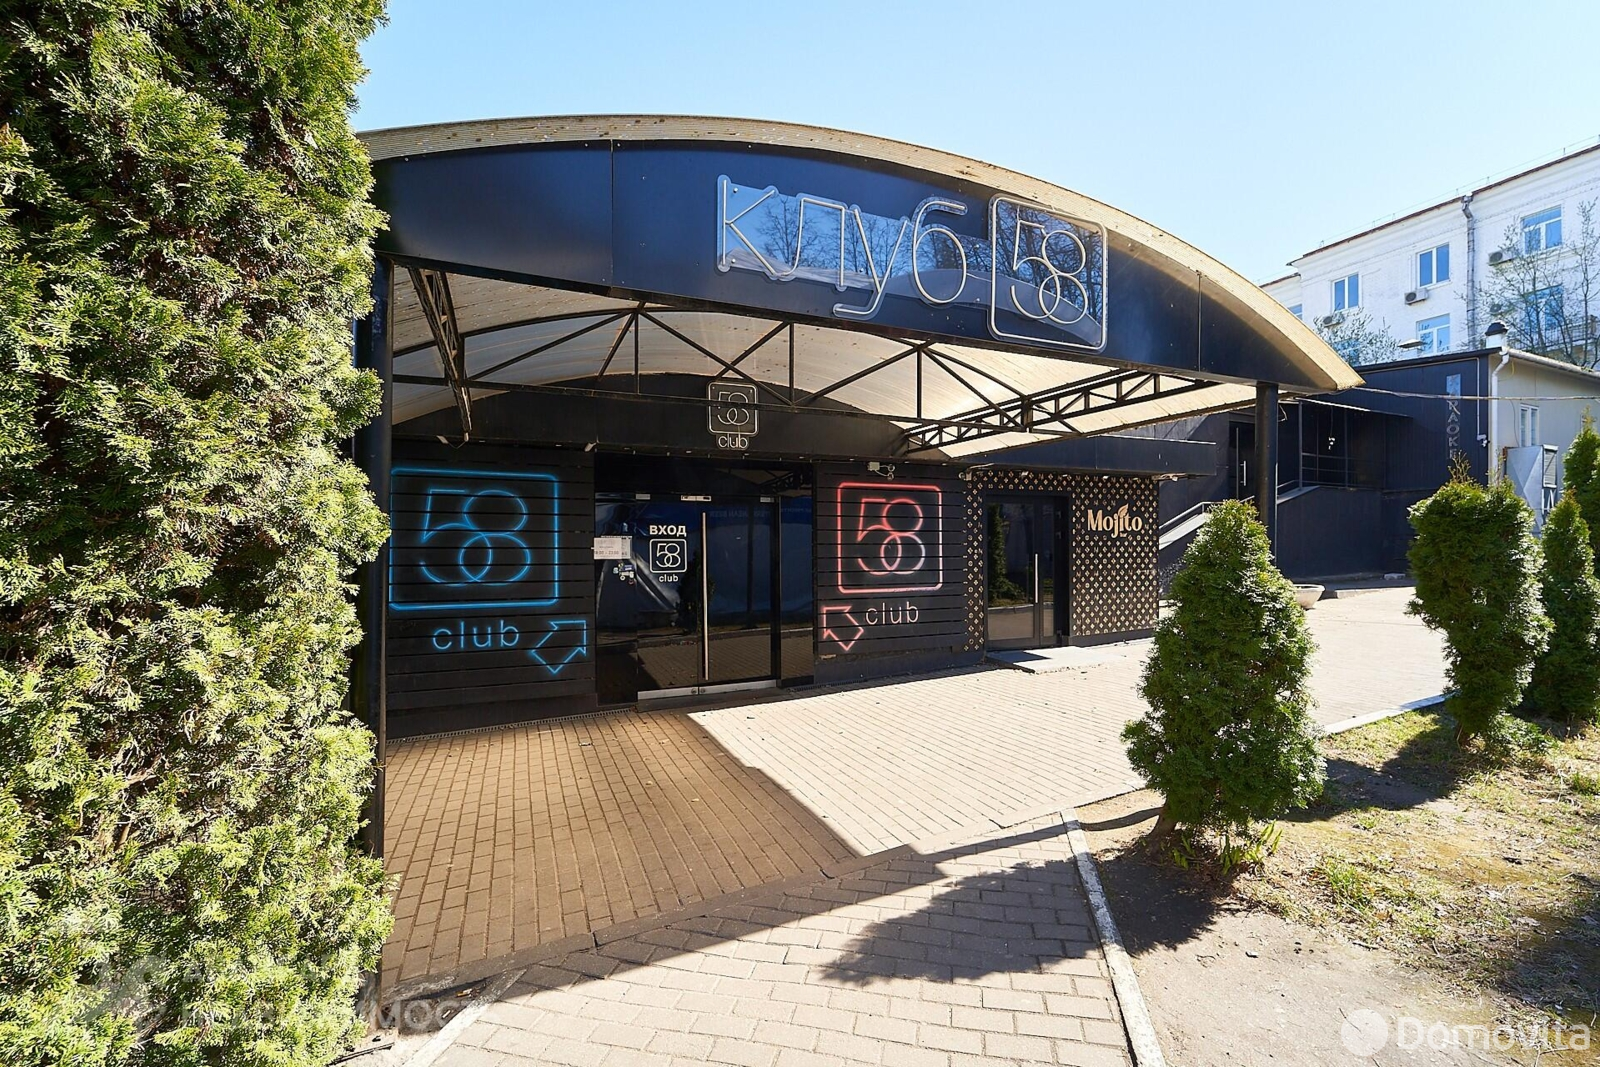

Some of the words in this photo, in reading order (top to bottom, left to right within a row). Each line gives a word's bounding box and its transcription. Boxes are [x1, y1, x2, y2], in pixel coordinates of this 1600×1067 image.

[717, 174, 968, 319] Клуб
[1010, 217, 1089, 325] 58
[718, 433, 748, 449] club
[649, 525, 687, 537] ВХОД
[1087, 503, 1143, 538] Mojito
[419, 487, 532, 587] 58
[857, 498, 926, 576] 58
[655, 543, 681, 568] 58
[658, 574, 679, 582] club
[866, 601, 919, 625] club
[432, 619, 520, 650] club
